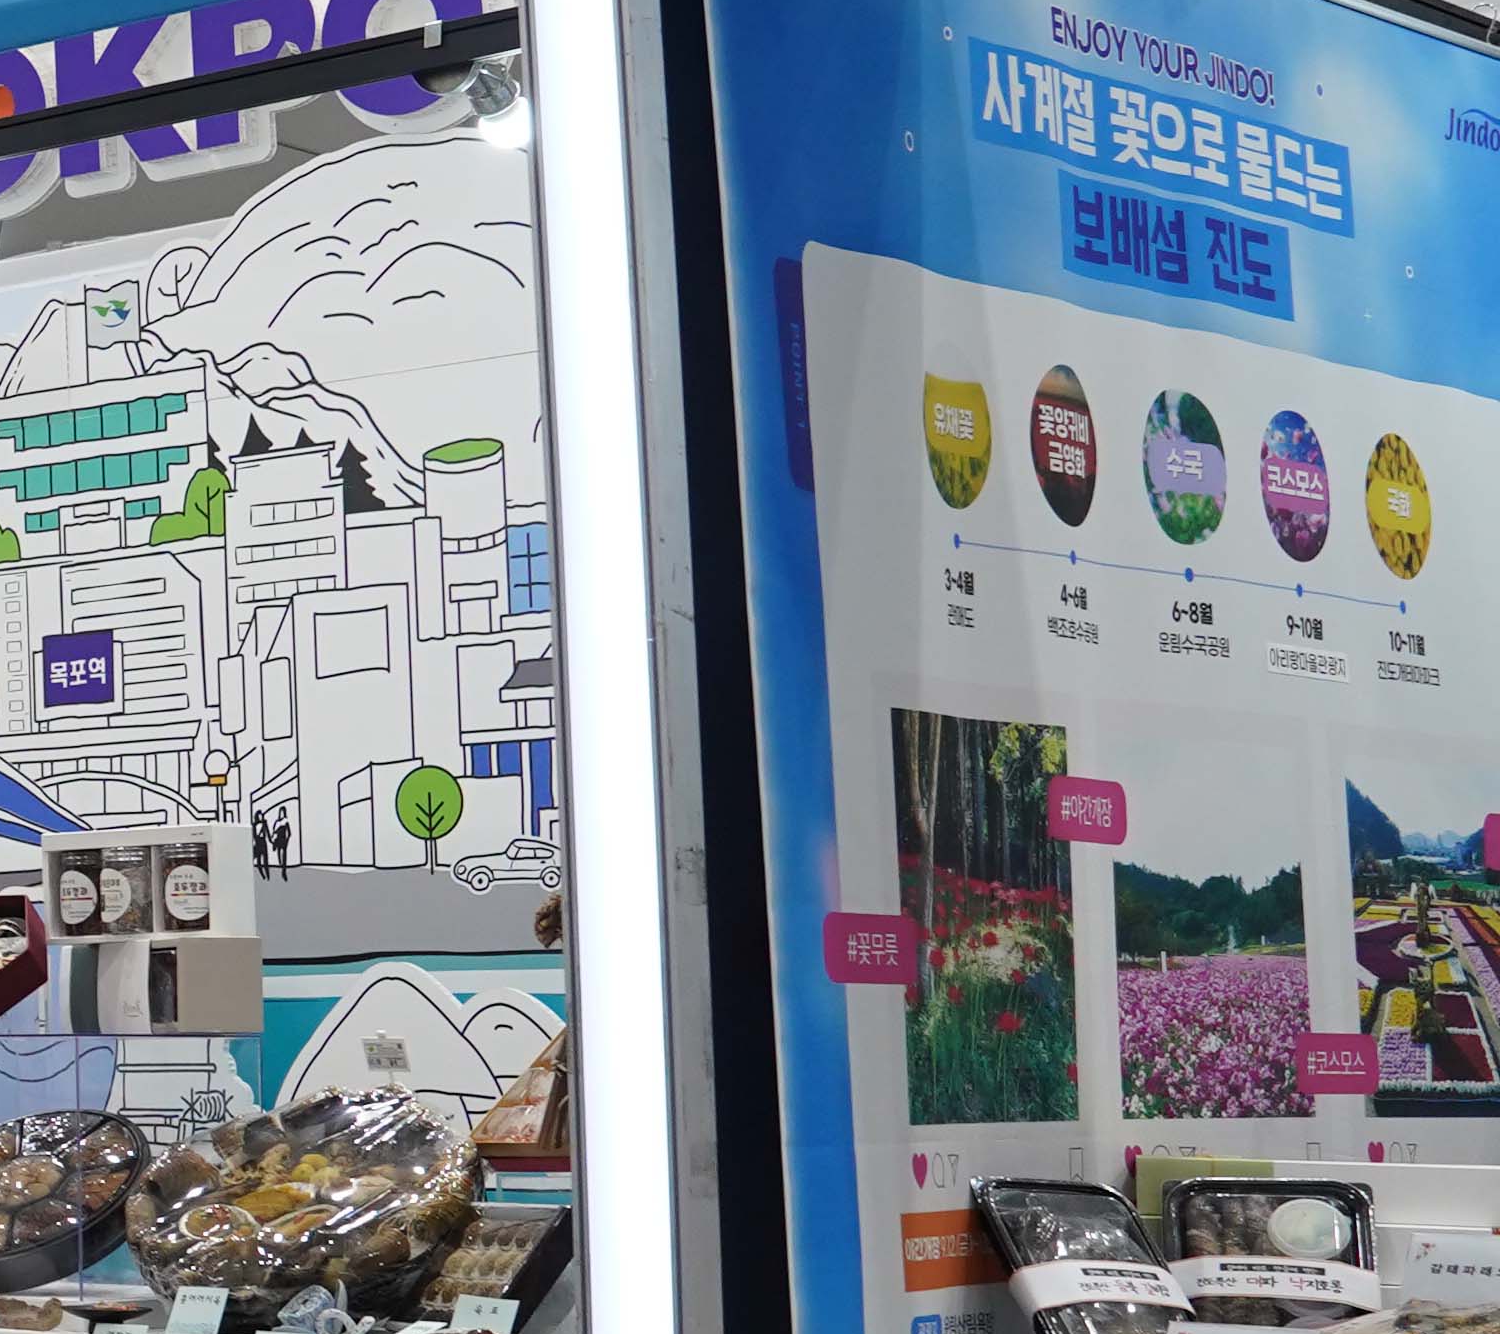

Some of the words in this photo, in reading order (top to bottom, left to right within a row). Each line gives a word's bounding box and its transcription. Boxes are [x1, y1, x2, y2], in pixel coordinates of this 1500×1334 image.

[1051, 6, 1127, 62] ENJOY
[1133, 31, 1201, 84] YOUR
[1204, 52, 1276, 107] JINDO!
[982, 52, 1098, 157] 사계절
[1109, 86, 1229, 187] 꽃으로
[1237, 121, 1342, 220] 물드는
[1073, 184, 1189, 284] 보배섬
[1205, 217, 1276, 302] 진도
[933, 402, 974, 441] 유채꽃
[1039, 404, 1089, 445] 꽃양귀비
[1166, 448, 1203, 480] 수국
[1267, 465, 1325, 500] 코스모스
[1172, 601, 1214, 625] 6~8월
[1286, 615, 1324, 641] 9~10월
[1159, 631, 1231, 659] 운림수국공원
[1388, 631, 1425, 657] 10~11월
[50, 657, 107, 688] 목포역
[1307, 1051, 1367, 1076] #코스모스
